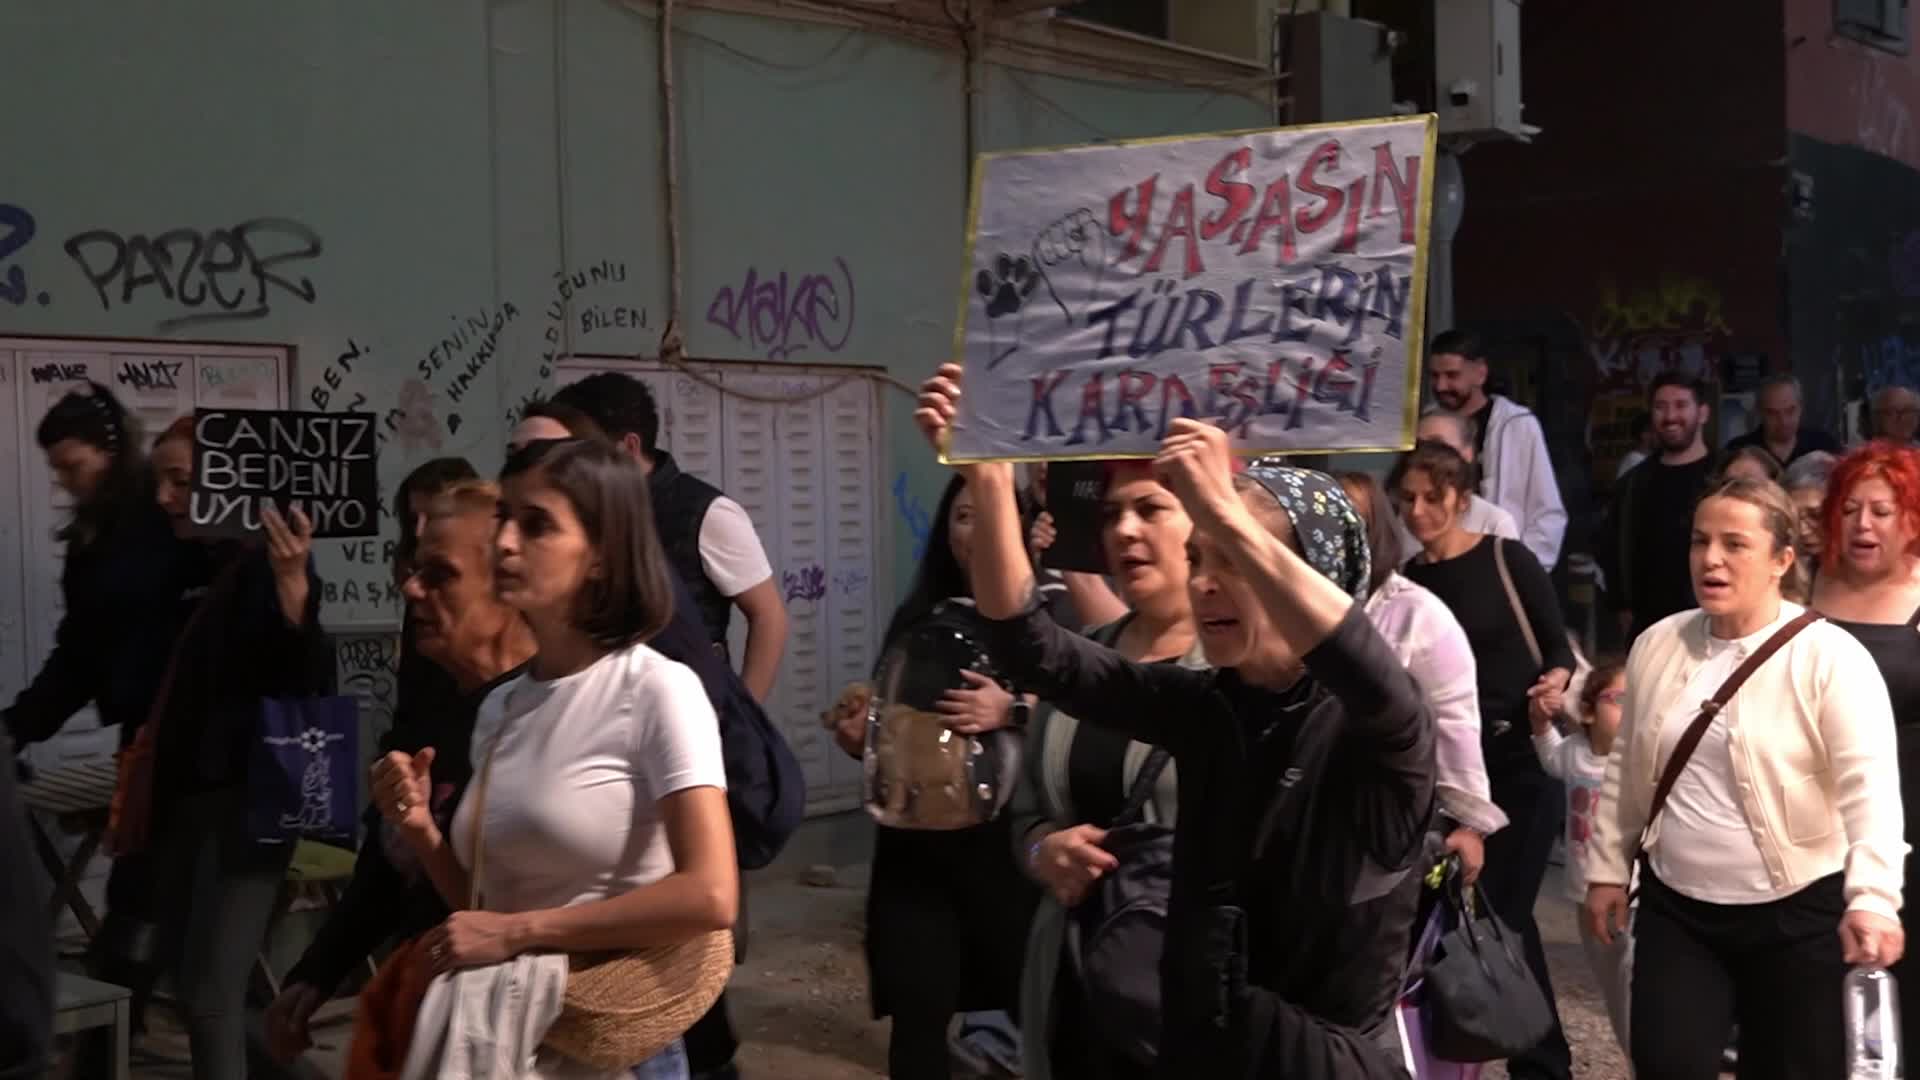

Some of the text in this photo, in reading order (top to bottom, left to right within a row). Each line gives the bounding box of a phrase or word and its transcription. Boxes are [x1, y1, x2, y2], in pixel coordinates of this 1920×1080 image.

[1107, 139, 1422, 279] YAŞASIN
[1087, 263, 1413, 362] TÜRLERİN
[195, 412, 371, 460] CANSIZ
[200, 450, 349, 498] BEDENİ
[189, 492, 367, 533] UYUYO
